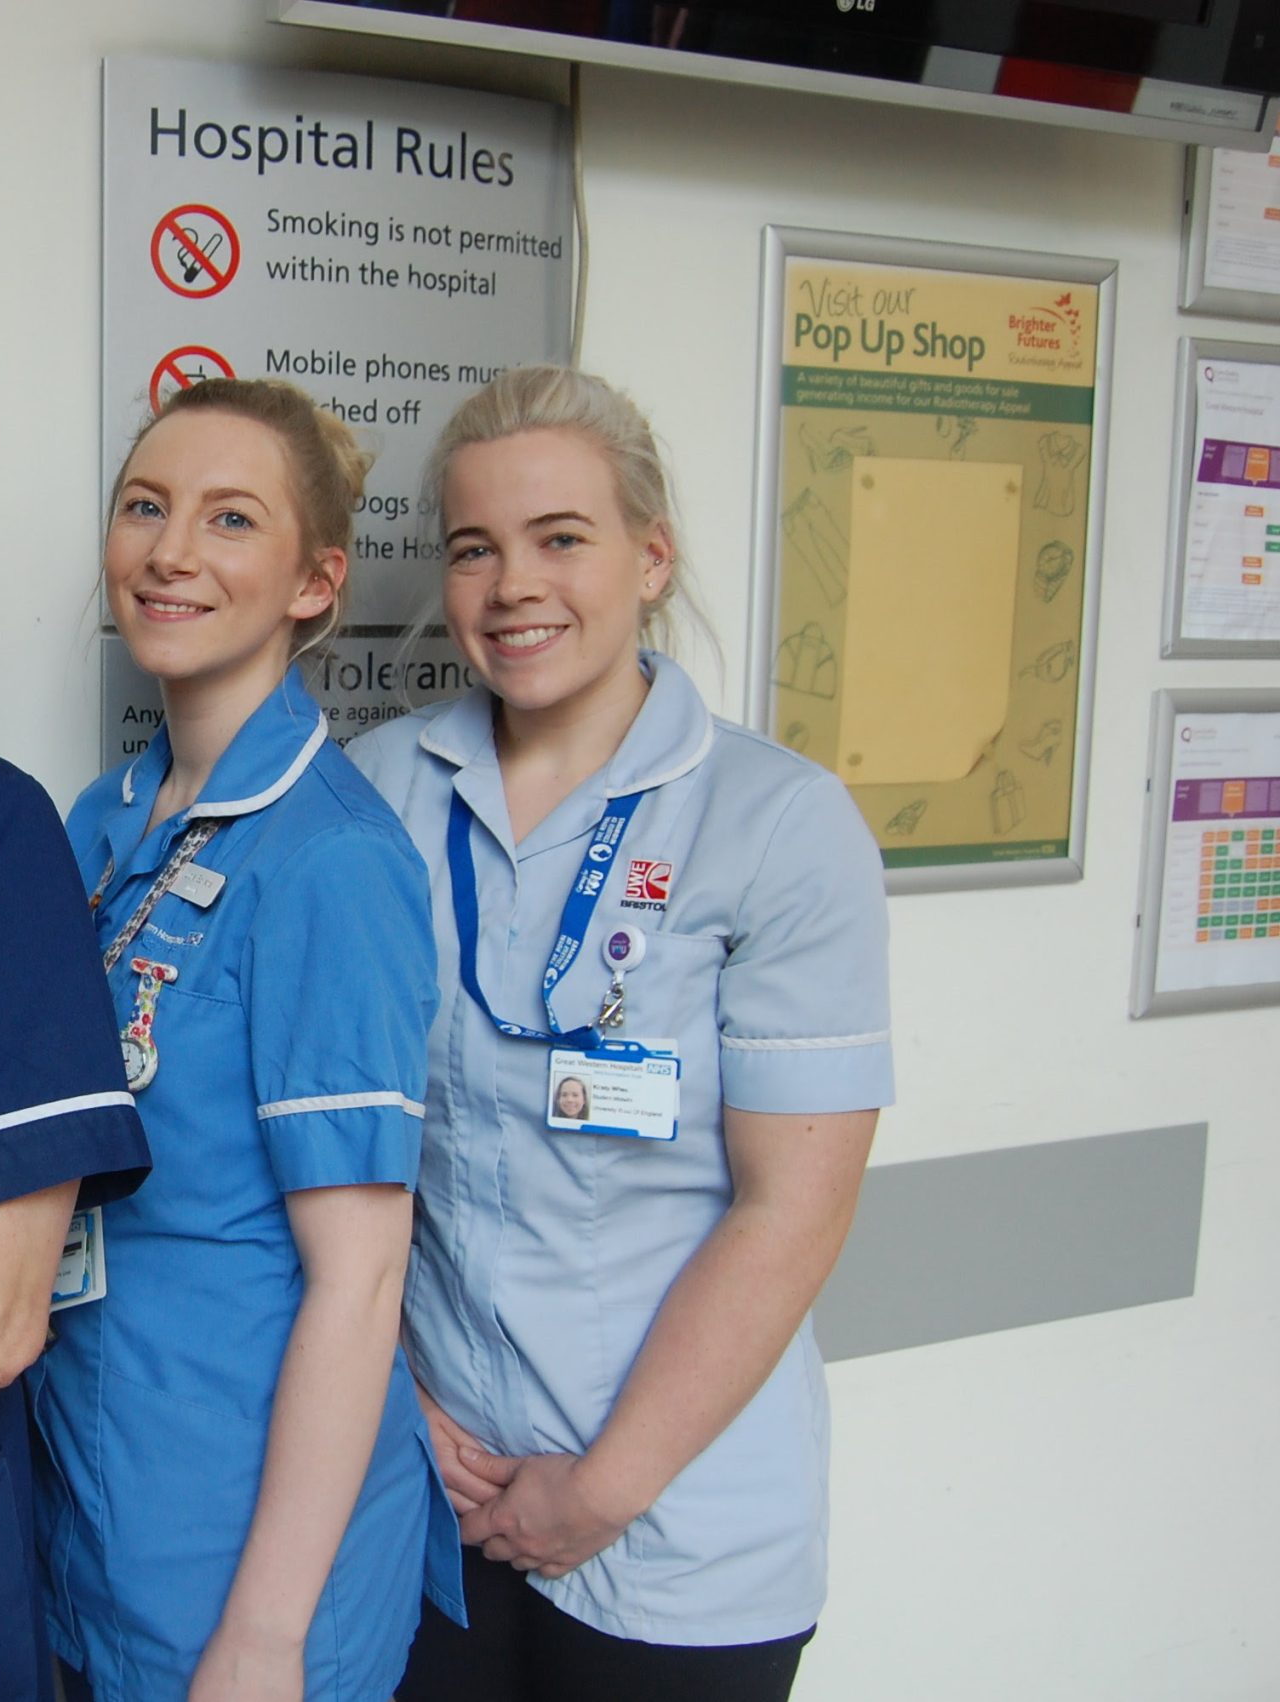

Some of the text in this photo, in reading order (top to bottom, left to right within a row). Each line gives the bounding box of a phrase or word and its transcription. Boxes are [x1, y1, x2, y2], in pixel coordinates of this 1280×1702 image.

[150, 107, 515, 187] Hospital Rules
[267, 208, 562, 259] Smoking is not permitted
[266, 256, 496, 297] within the hospital
[799, 278, 916, 318] Visit our
[1008, 314, 1057, 334] Brighter
[794, 313, 986, 372] Pop Up Shop
[1017, 332, 1061, 350] Futures
[266, 349, 507, 384] Mobile phones mus
[846, 375, 858, 386] of
[860, 376, 907, 390] beautiful
[909, 380, 932, 394] gifts
[933, 381, 953, 393] and
[954, 383, 983, 396] goods
[985, 383, 1000, 396] for
[386, 400, 421, 424] off
[797, 390, 1031, 414] generating income for our Radiotherapy Appeal
[355, 535, 394, 559] the
[122, 705, 165, 728] Any
[583, 870, 603, 896] YOU
[626, 862, 646, 897] UWE
[620, 899, 667, 911] BRISTOL
[647, 1063, 671, 1075] NHS
